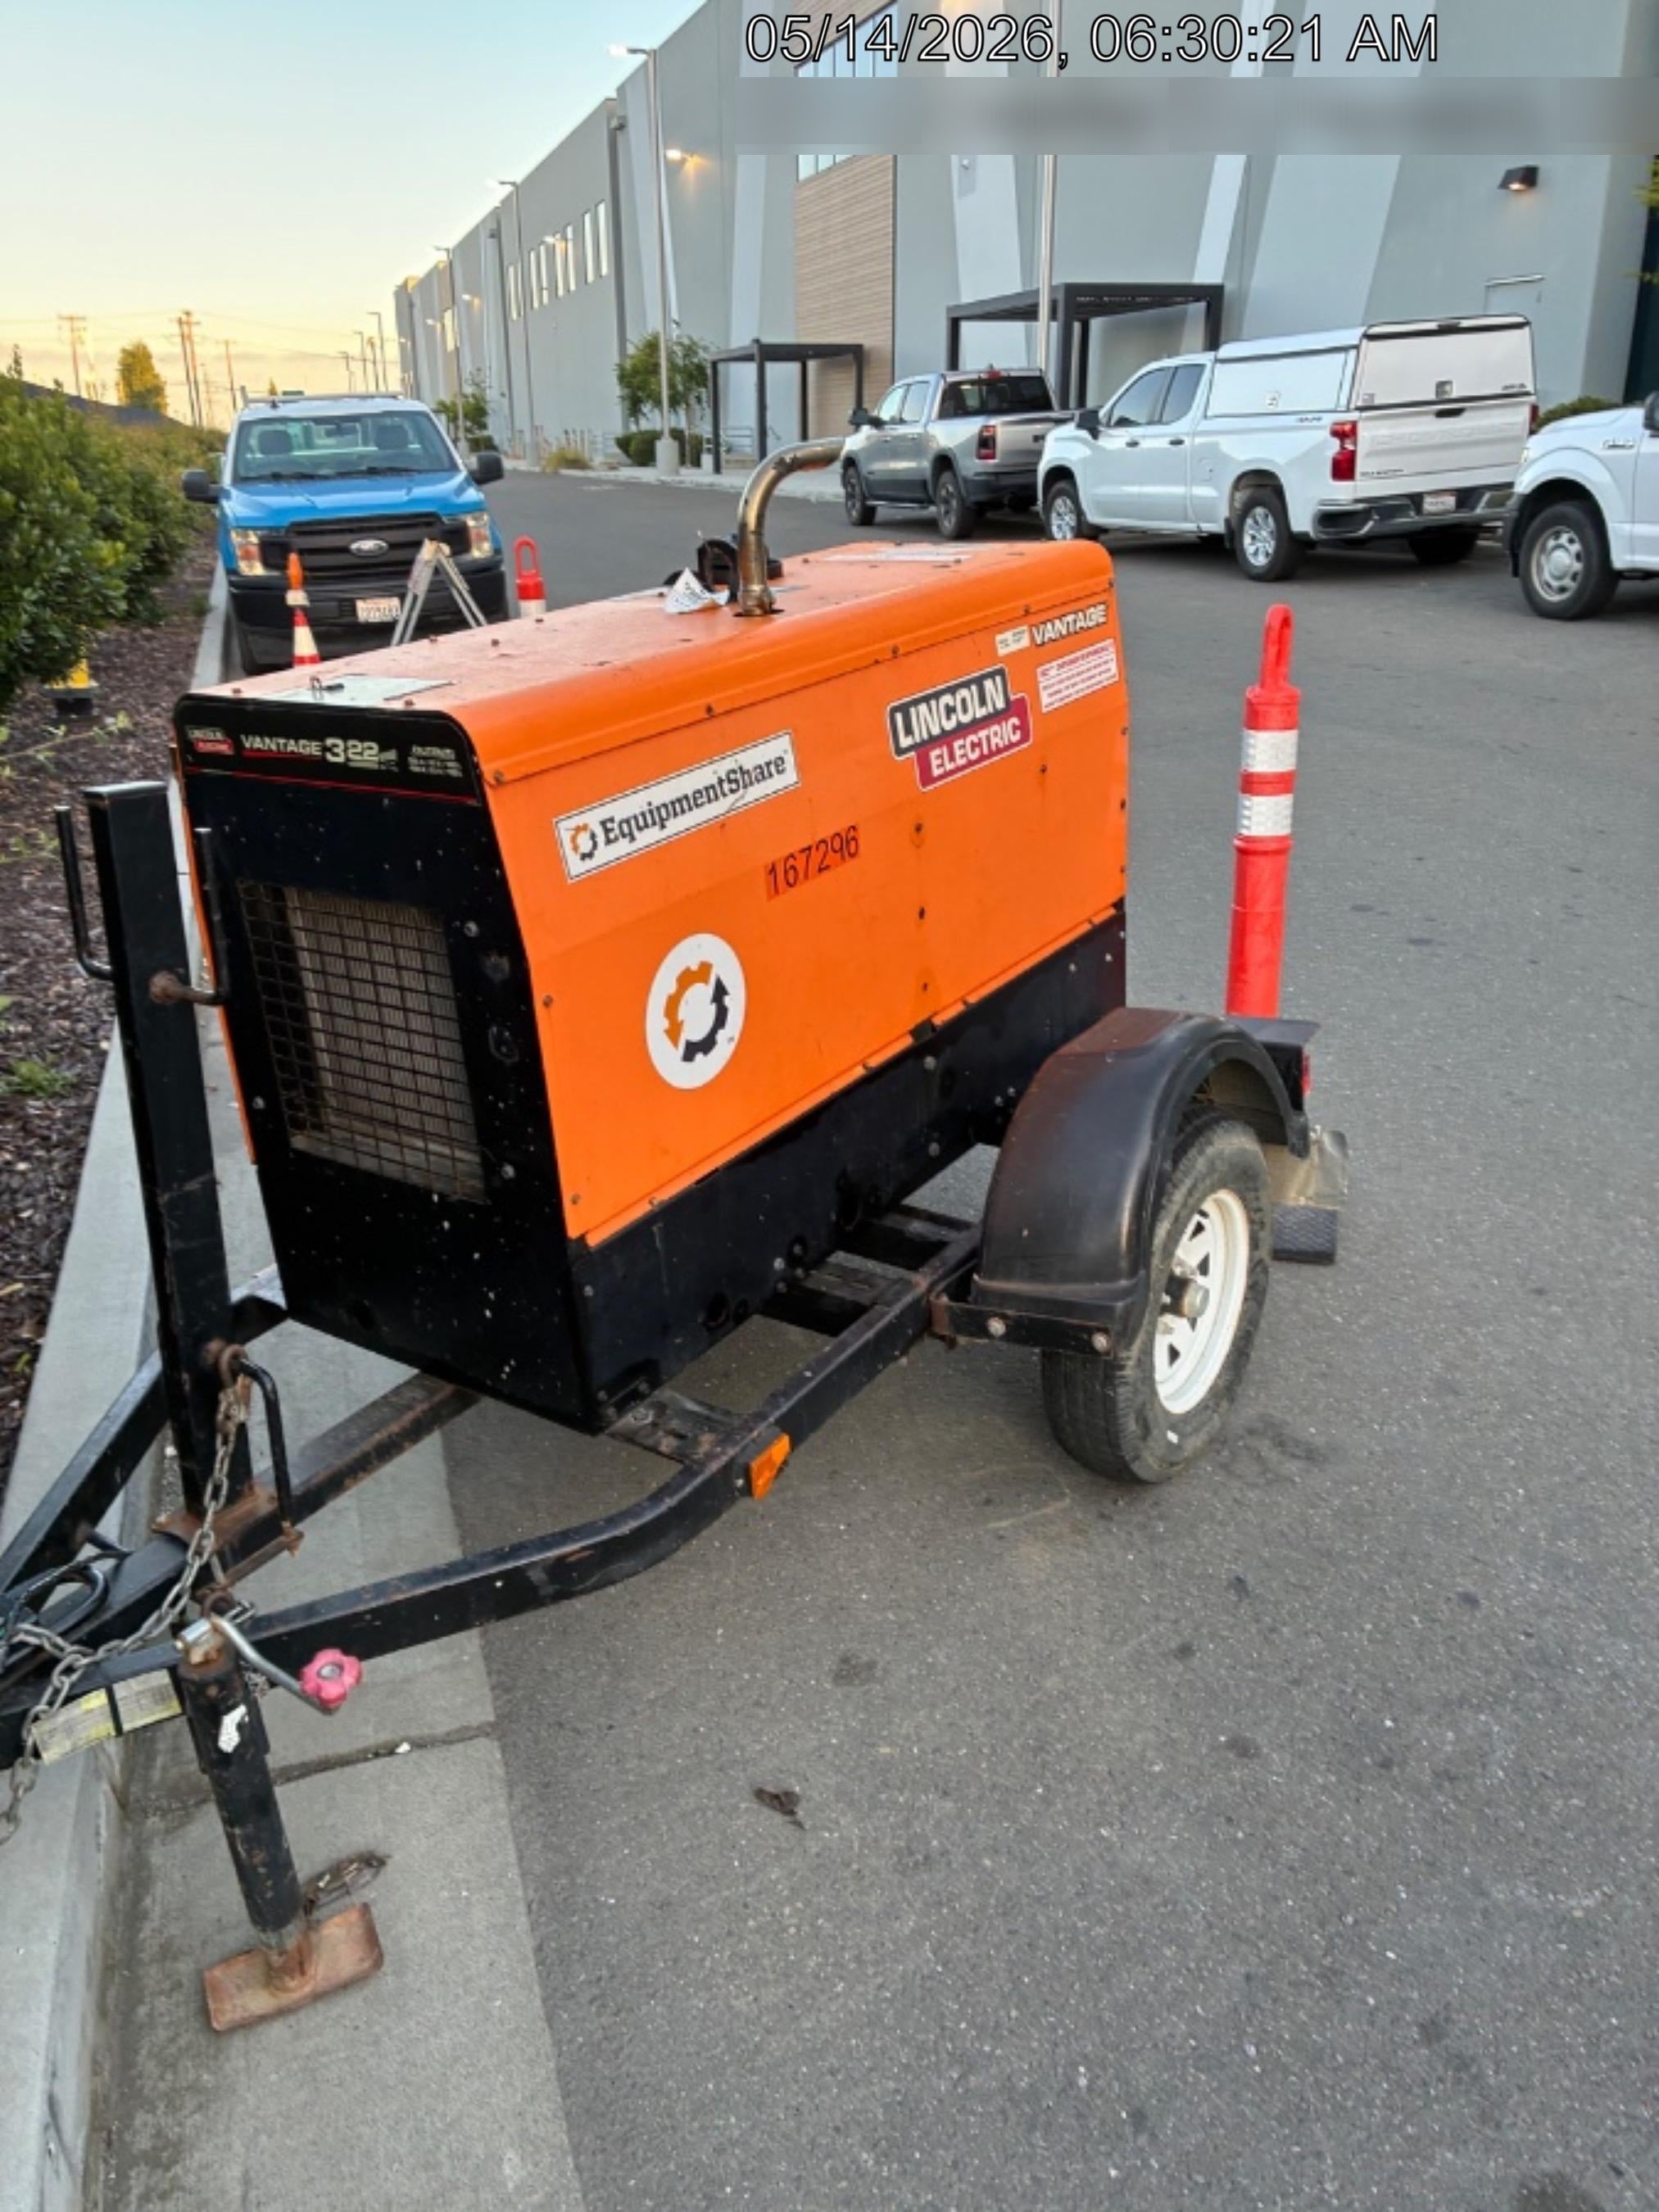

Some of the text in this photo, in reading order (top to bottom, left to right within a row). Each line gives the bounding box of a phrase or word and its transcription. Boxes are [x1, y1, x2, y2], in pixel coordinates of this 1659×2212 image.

[1031, 602, 1107, 646] VANTAGE
[895, 674, 1006, 749] LINCOLN
[240, 734, 323, 755] VANTAGE
[325, 737, 379, 764] 322
[929, 716, 1022, 777] ELECTRIC
[599, 754, 786, 846] EquipmentShare
[767, 825, 860, 896] 167296
